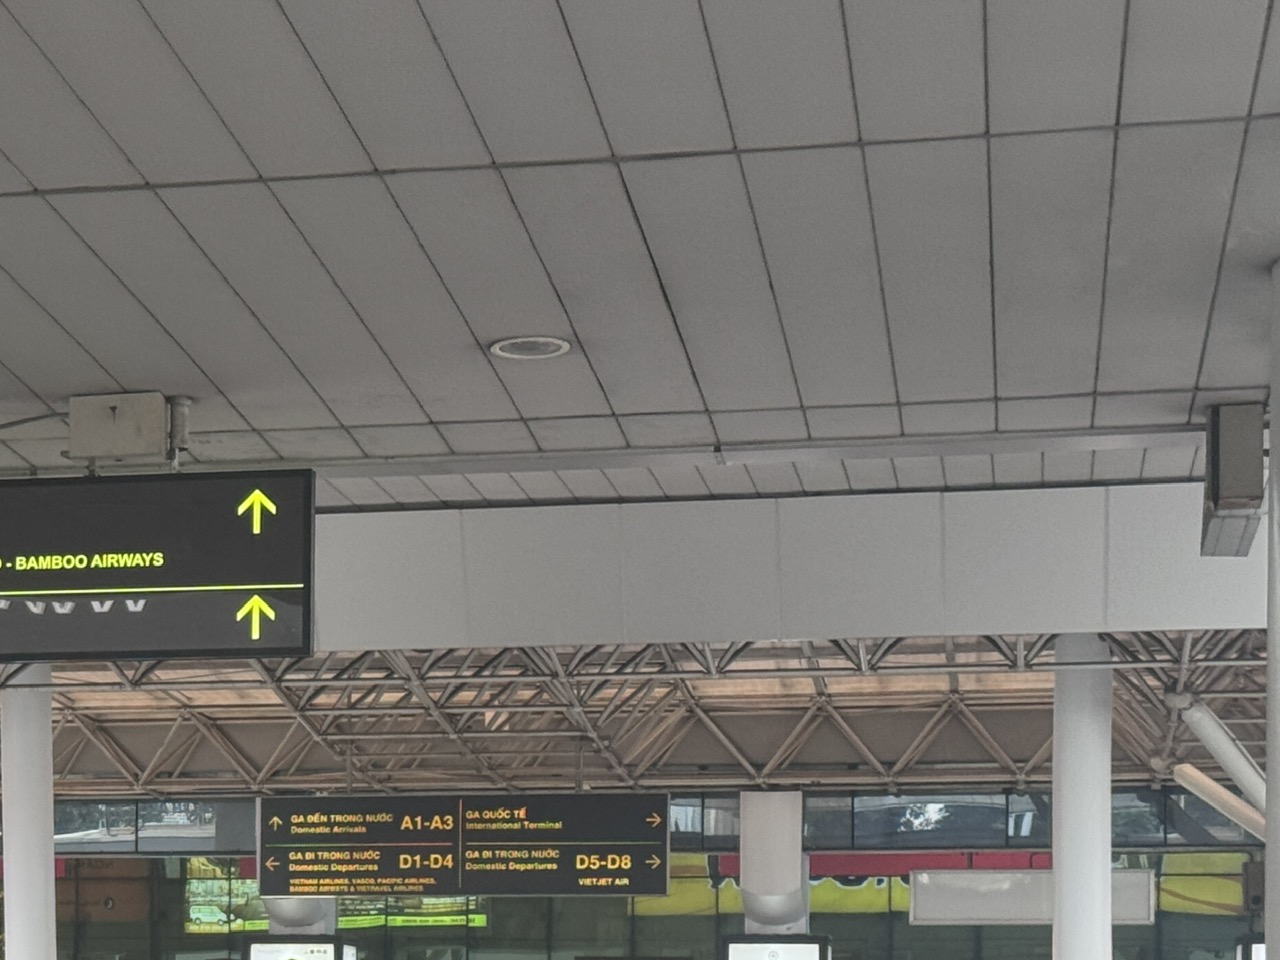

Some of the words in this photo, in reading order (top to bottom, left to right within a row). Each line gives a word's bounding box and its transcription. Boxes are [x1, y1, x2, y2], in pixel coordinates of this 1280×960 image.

[15, 554, 87, 570] BAMBOO
[91, 552, 164, 568] AIRWAYS
[466, 810, 480, 819] GA
[482, 807, 511, 819] QUỐC
[290, 814, 305, 823] GA
[329, 814, 364, 823] TRONG
[400, 815, 454, 830] A1-A3
[290, 826, 331, 834] Domestic
[332, 825, 367, 833] Arrivals
[466, 822, 522, 830] International
[523, 821, 563, 829] Terminal
[288, 852, 303, 860] GA
[305, 852, 315, 860] ĐI
[317, 851, 351, 860] TRONG
[466, 850, 480, 859] GA
[482, 850, 492, 858] ĐI
[495, 850, 529, 859] TRONG
[399, 854, 454, 869] D1-D4
[576, 854, 632, 870] D5-D8
[289, 863, 329, 872] Domestic
[331, 863, 379, 873] Departures
[465, 862, 507, 870] Domestic
[508, 862, 558, 872] Departures
[578, 878, 613, 887] VIETJET
[614, 877, 630, 887] AIR
